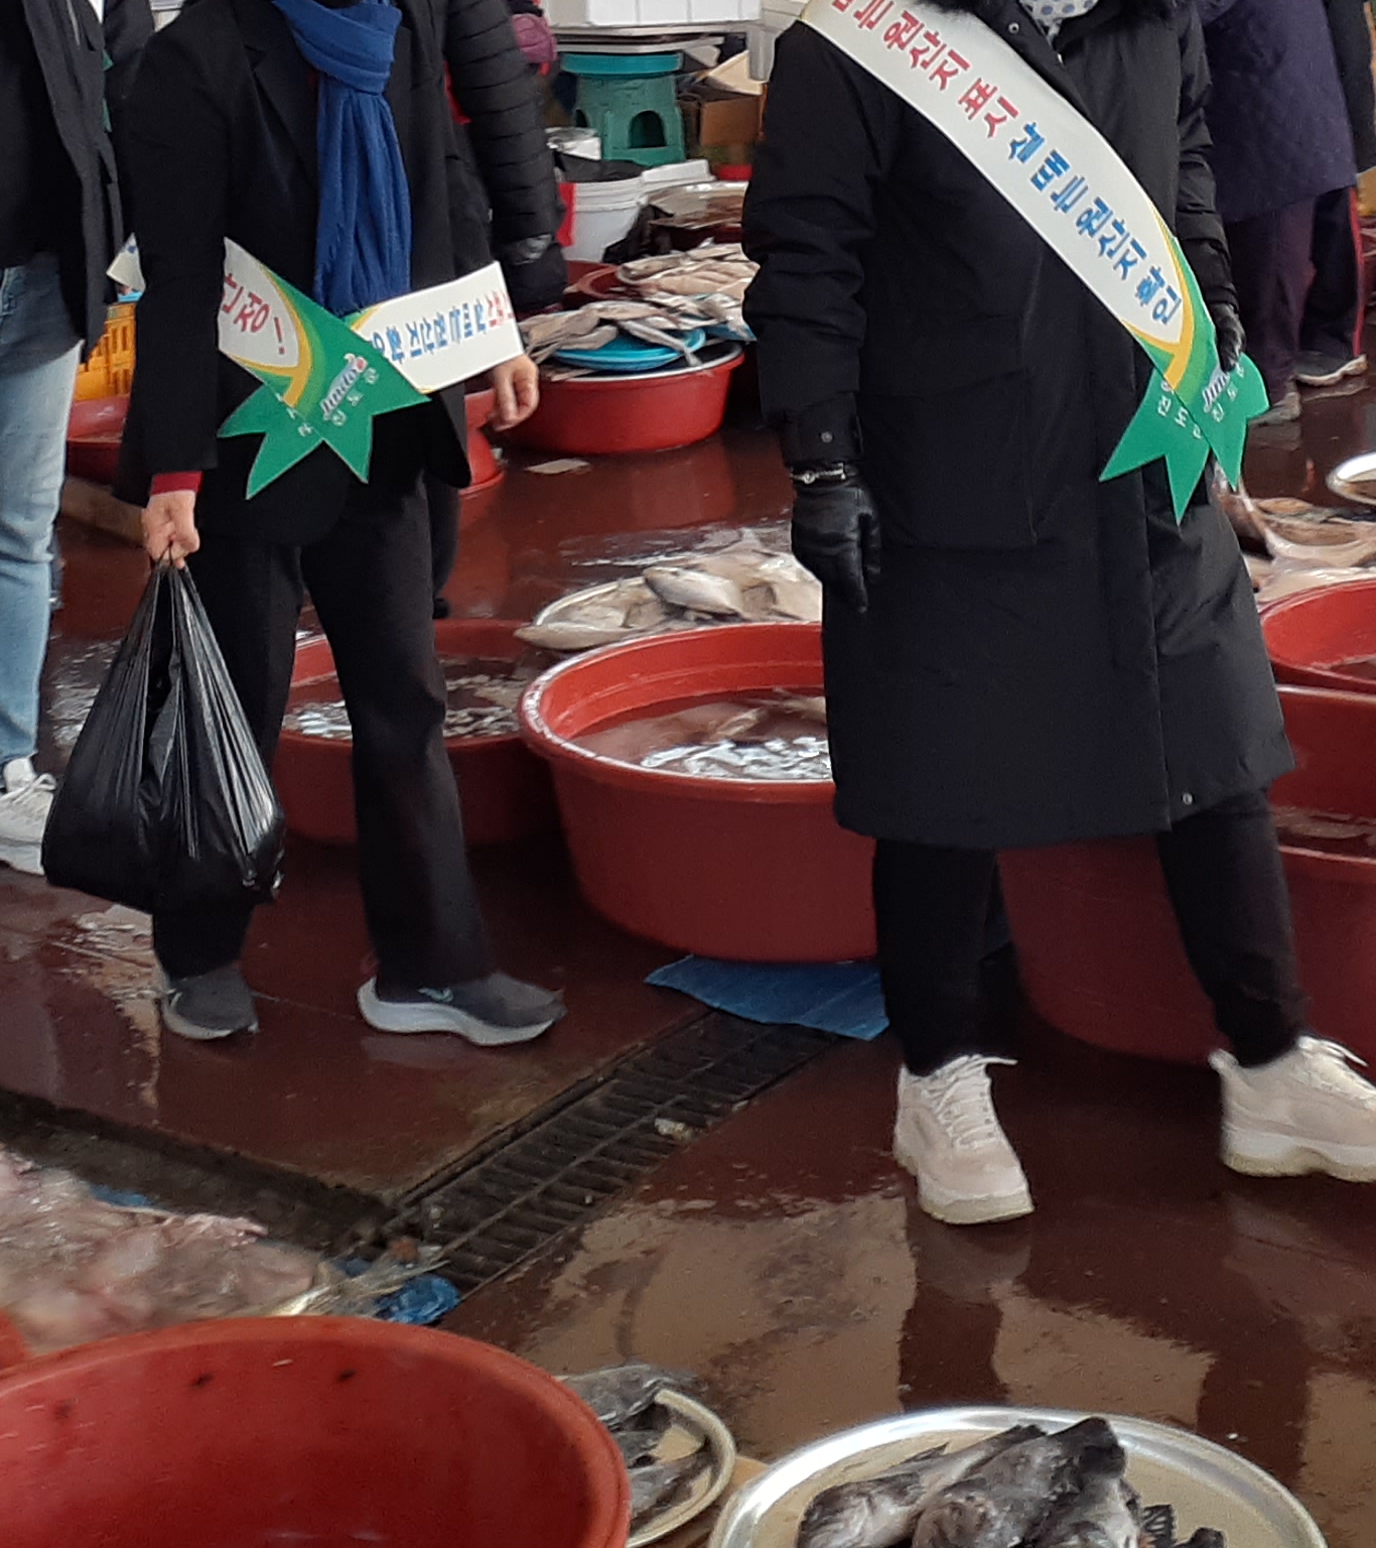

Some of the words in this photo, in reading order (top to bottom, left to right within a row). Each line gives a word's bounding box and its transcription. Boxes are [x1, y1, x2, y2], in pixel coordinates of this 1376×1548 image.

[882, 9, 972, 91] 원산지
[957, 76, 1020, 139] 표시
[1007, 120, 1047, 165] 살
[1028, 148, 1090, 214] 때는
[1075, 196, 1149, 281] 원산지
[1133, 264, 1184, 326] 확인
